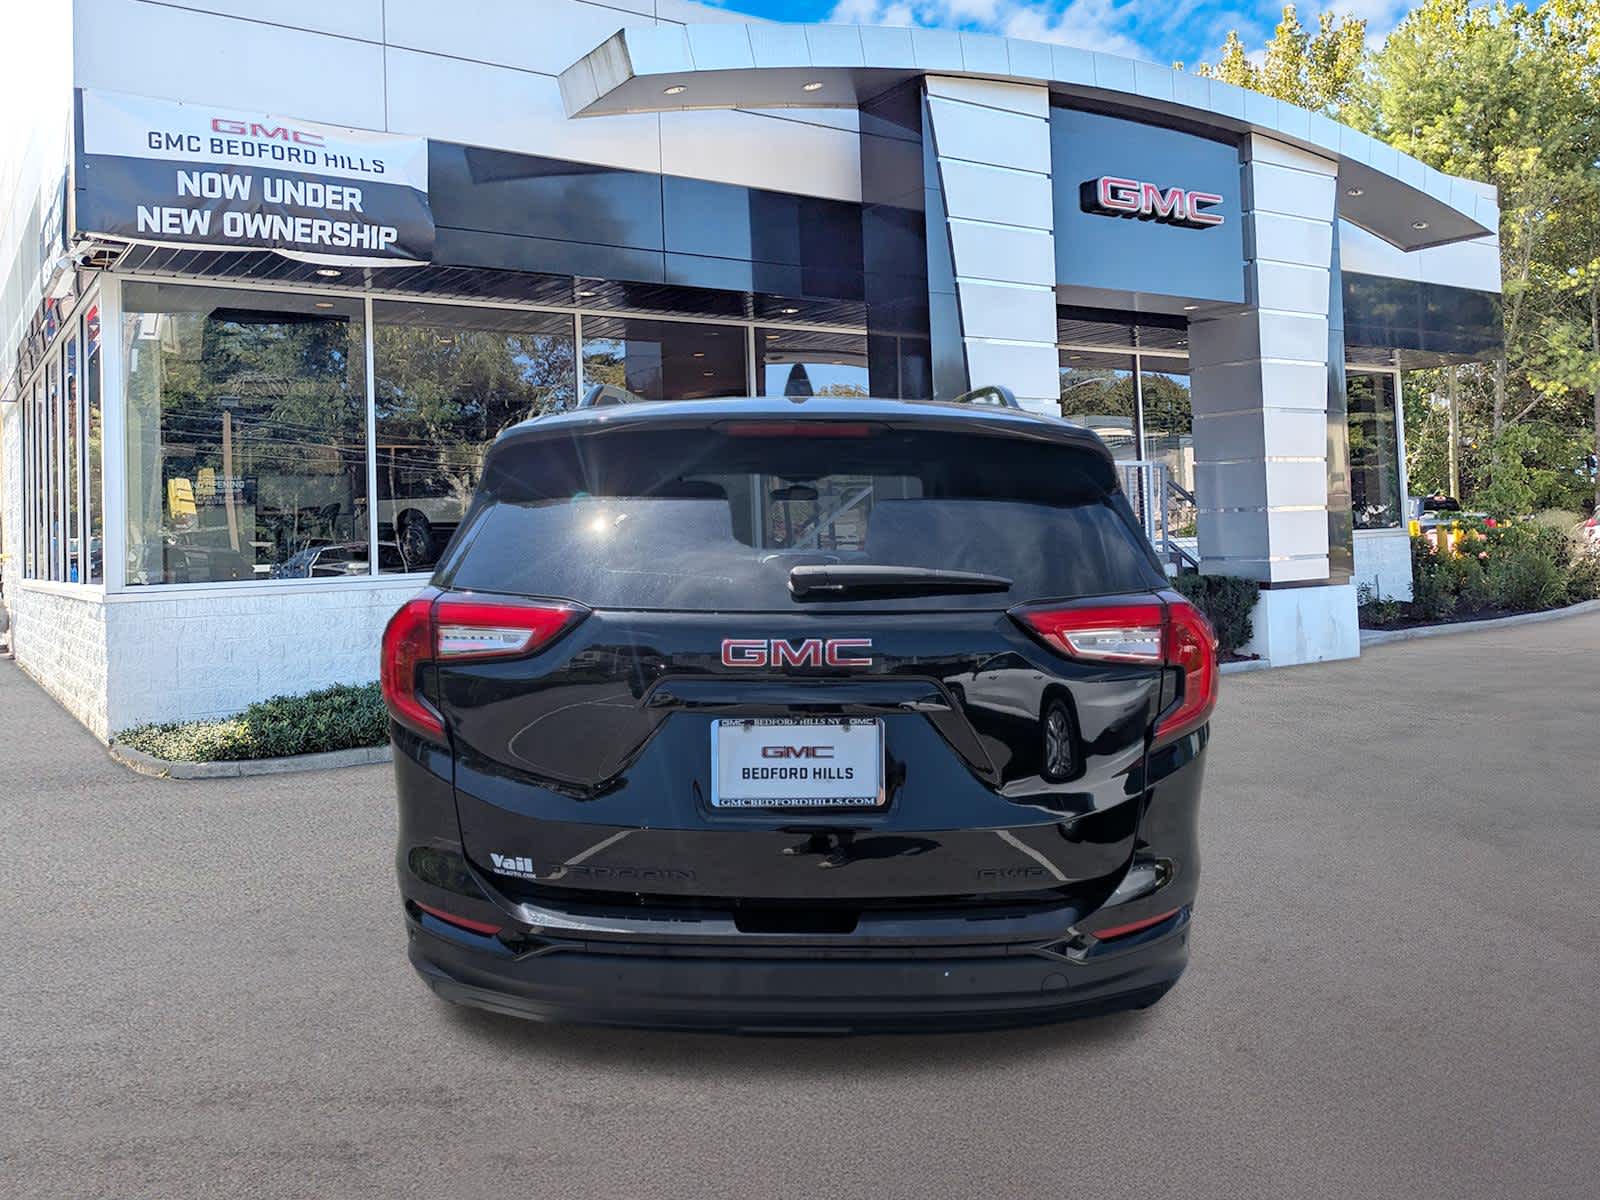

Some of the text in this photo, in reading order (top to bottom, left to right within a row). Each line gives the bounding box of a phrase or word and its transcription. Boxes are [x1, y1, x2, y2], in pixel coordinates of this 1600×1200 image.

[211, 118, 327, 148] GMC
[148, 131, 385, 174] GMC BEDFORD HILLS
[177, 169, 364, 213] NOW UNDER
[1096, 176, 1225, 225] GMC
[136, 205, 398, 250] NEW OWNERSHIP
[721, 638, 873, 667] GMC
[849, 718, 873, 726] GMC
[761, 746, 835, 759] GMC
[742, 767, 854, 780] BEDFORD HILLS
[720, 797, 875, 807] GMCBEDFORDHILLS.COM
[490, 852, 533, 873] Vail
